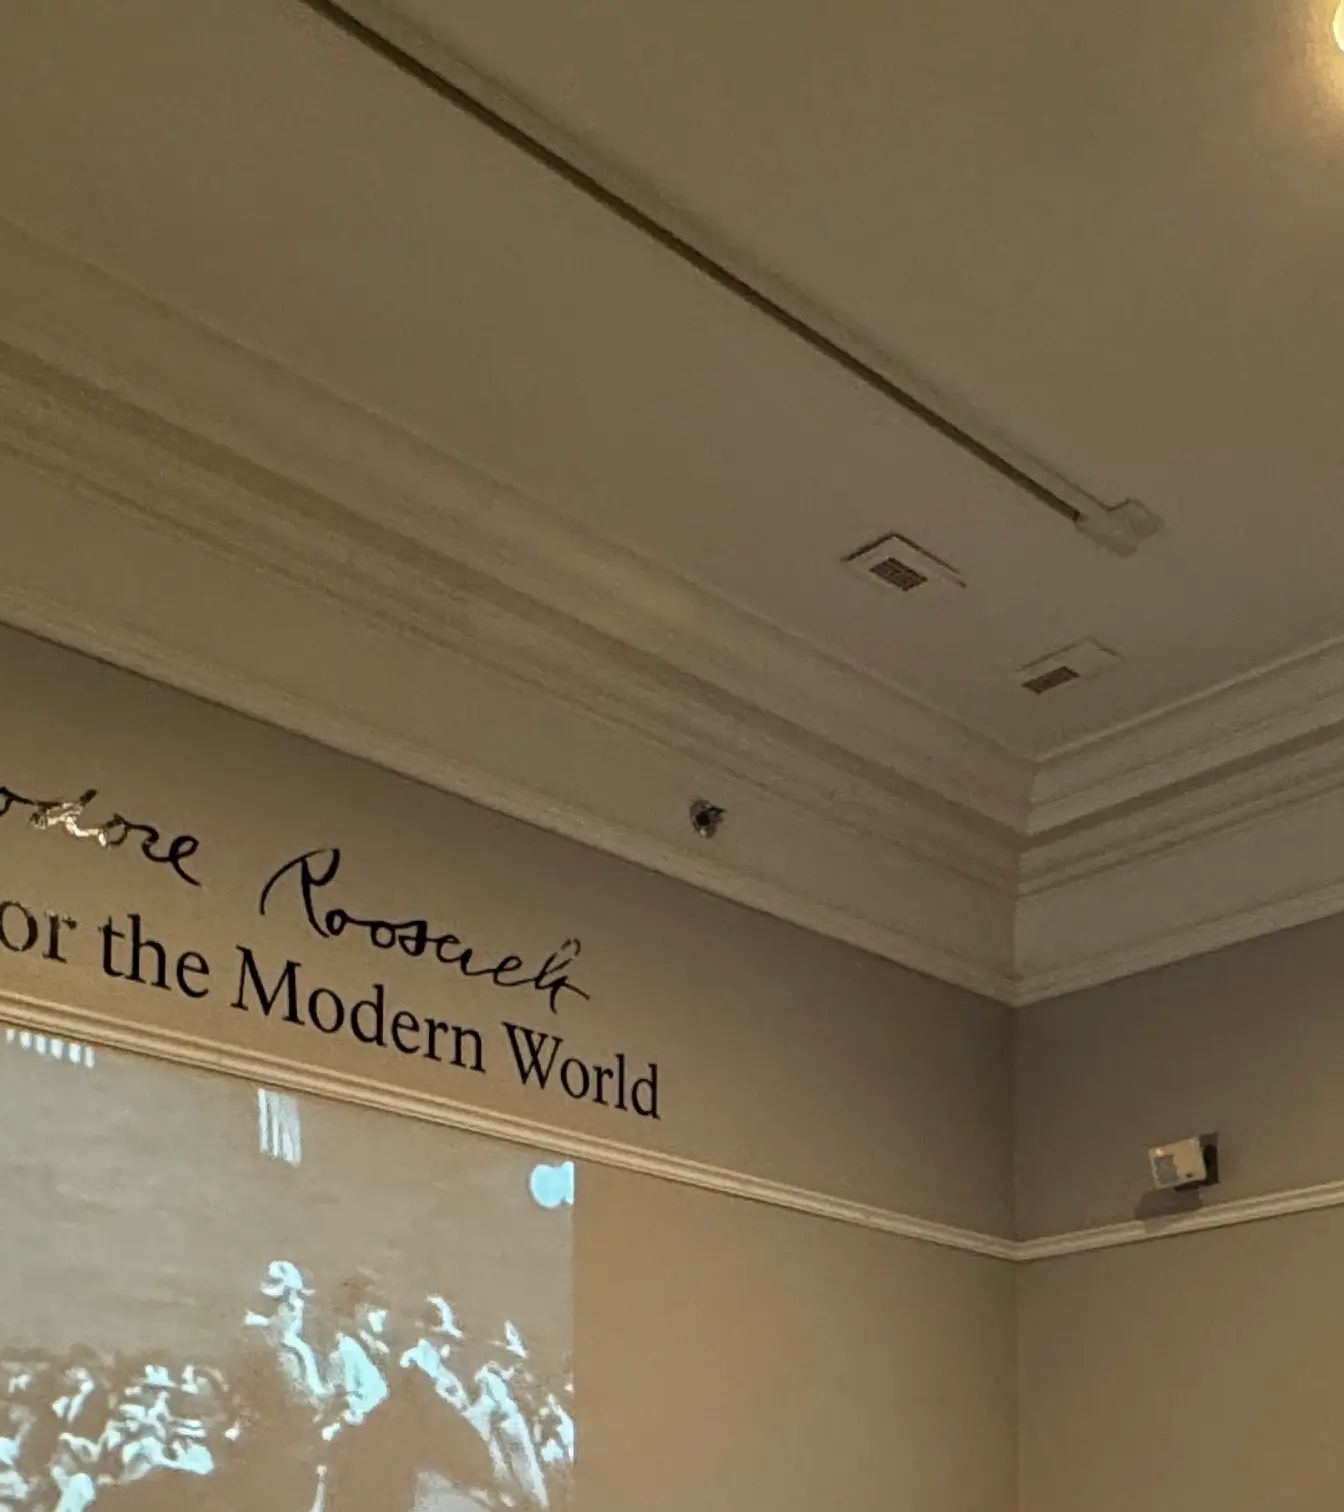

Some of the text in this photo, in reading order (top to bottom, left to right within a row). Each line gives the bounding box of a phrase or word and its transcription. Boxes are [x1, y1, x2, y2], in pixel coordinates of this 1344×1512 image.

[98, 913, 210, 999] the
[230, 944, 487, 1075] Modern
[501, 1020, 662, 1121] World
[259, 847, 591, 1015] Roosevelt
